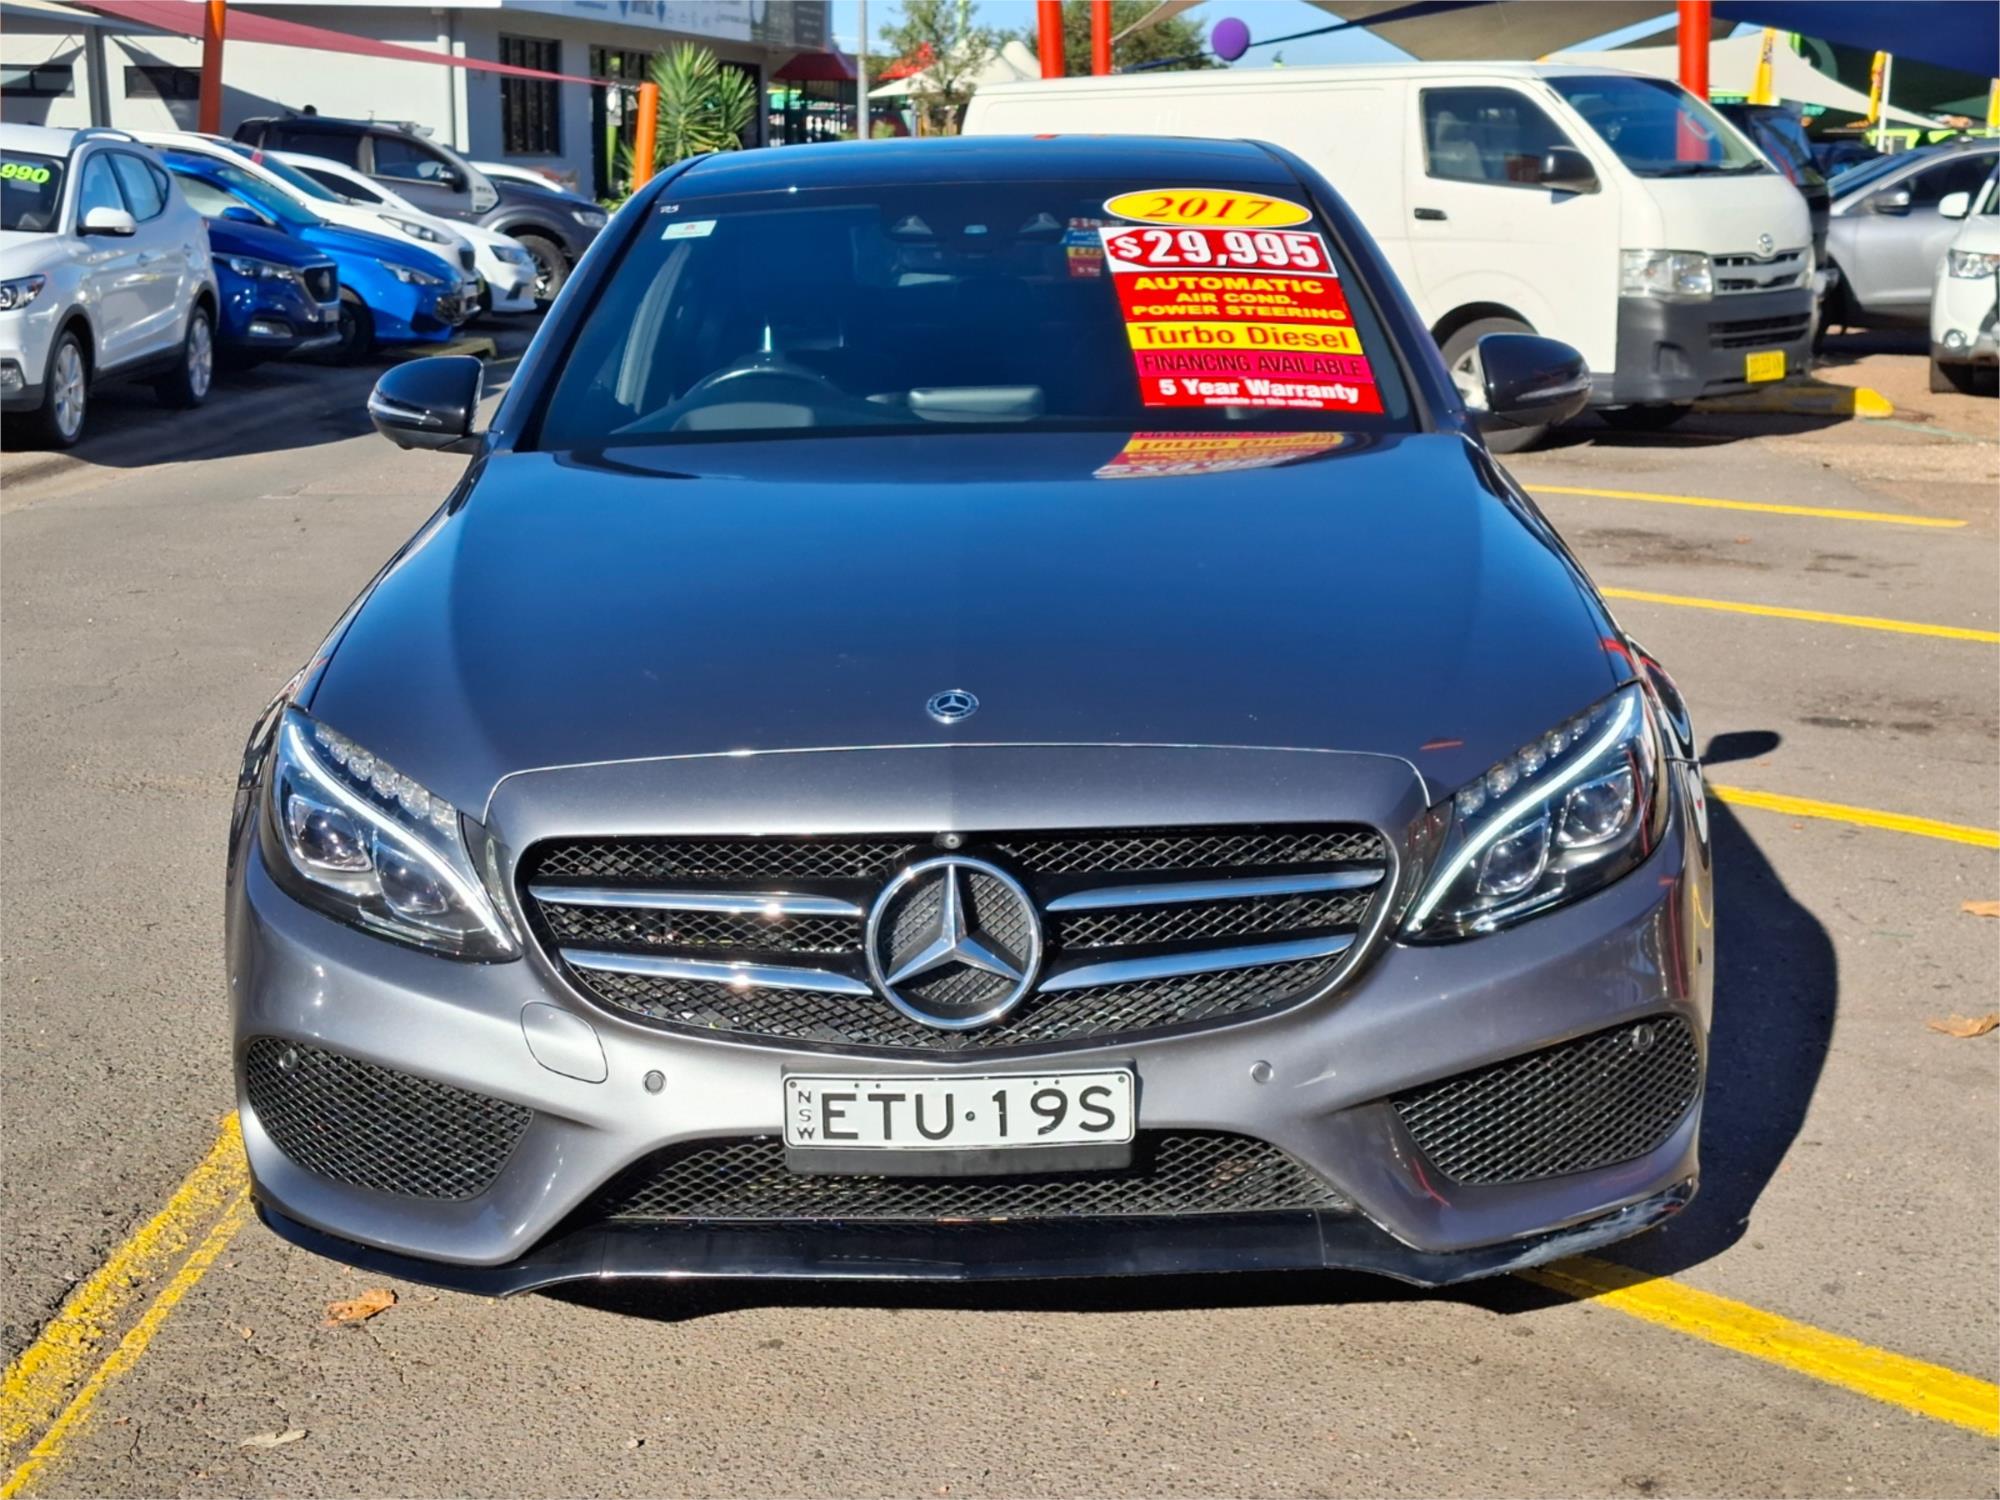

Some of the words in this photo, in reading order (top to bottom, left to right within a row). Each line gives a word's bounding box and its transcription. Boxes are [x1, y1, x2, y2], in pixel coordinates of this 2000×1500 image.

[1143, 197, 1273, 220] 2017
[1113, 230, 1320, 268] $29,995
[1134, 276, 1325, 294] AUTOMATIC
[1176, 292, 1218, 303] AIR
[1223, 293, 1299, 306] COND.
[1132, 305, 1220, 316] POWER
[1226, 305, 1347, 320] STEERING
[1138, 326, 1235, 345] Turbo
[1246, 326, 1350, 348] Diesel
[1143, 354, 1250, 372] FINANCING
[1257, 355, 1362, 376] AVAILABLE
[1158, 378, 1177, 396] 5
[1181, 378, 1240, 396] Year
[1243, 378, 1360, 403] Warranty
